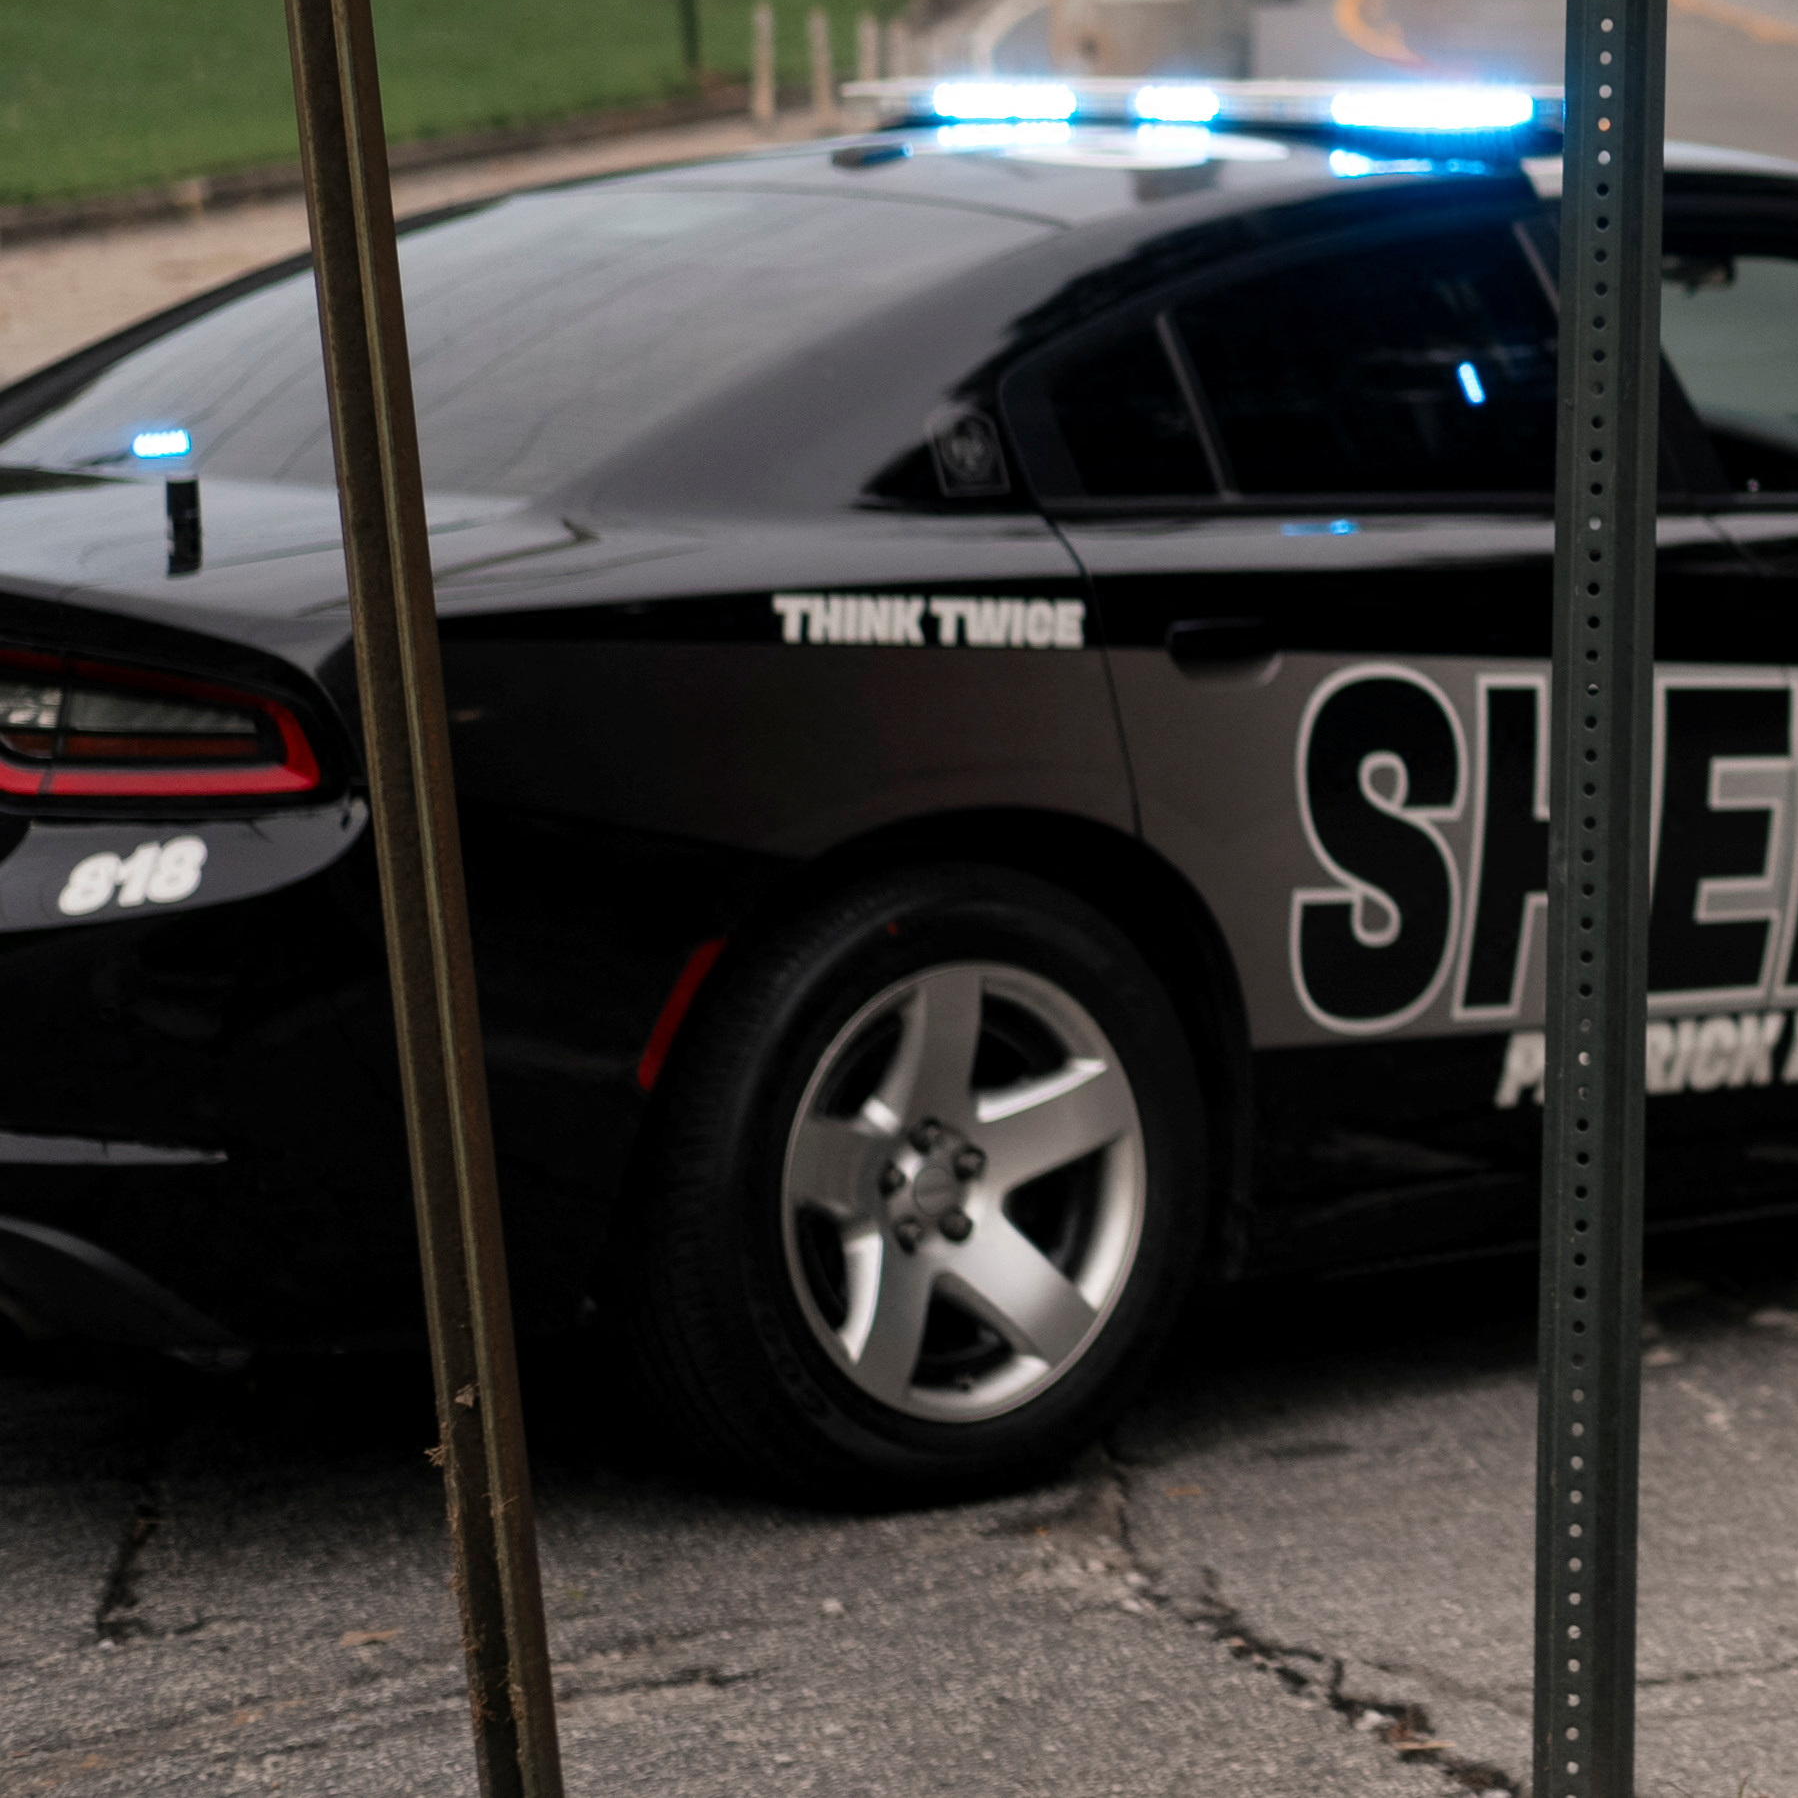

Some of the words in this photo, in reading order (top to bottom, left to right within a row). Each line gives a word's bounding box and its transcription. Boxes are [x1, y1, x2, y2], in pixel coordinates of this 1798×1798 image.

[772, 593, 926, 645] THINK
[929, 595, 1086, 648] TWICE
[57, 834, 208, 916] 818
[1494, 1011, 1786, 1106] PRICK
